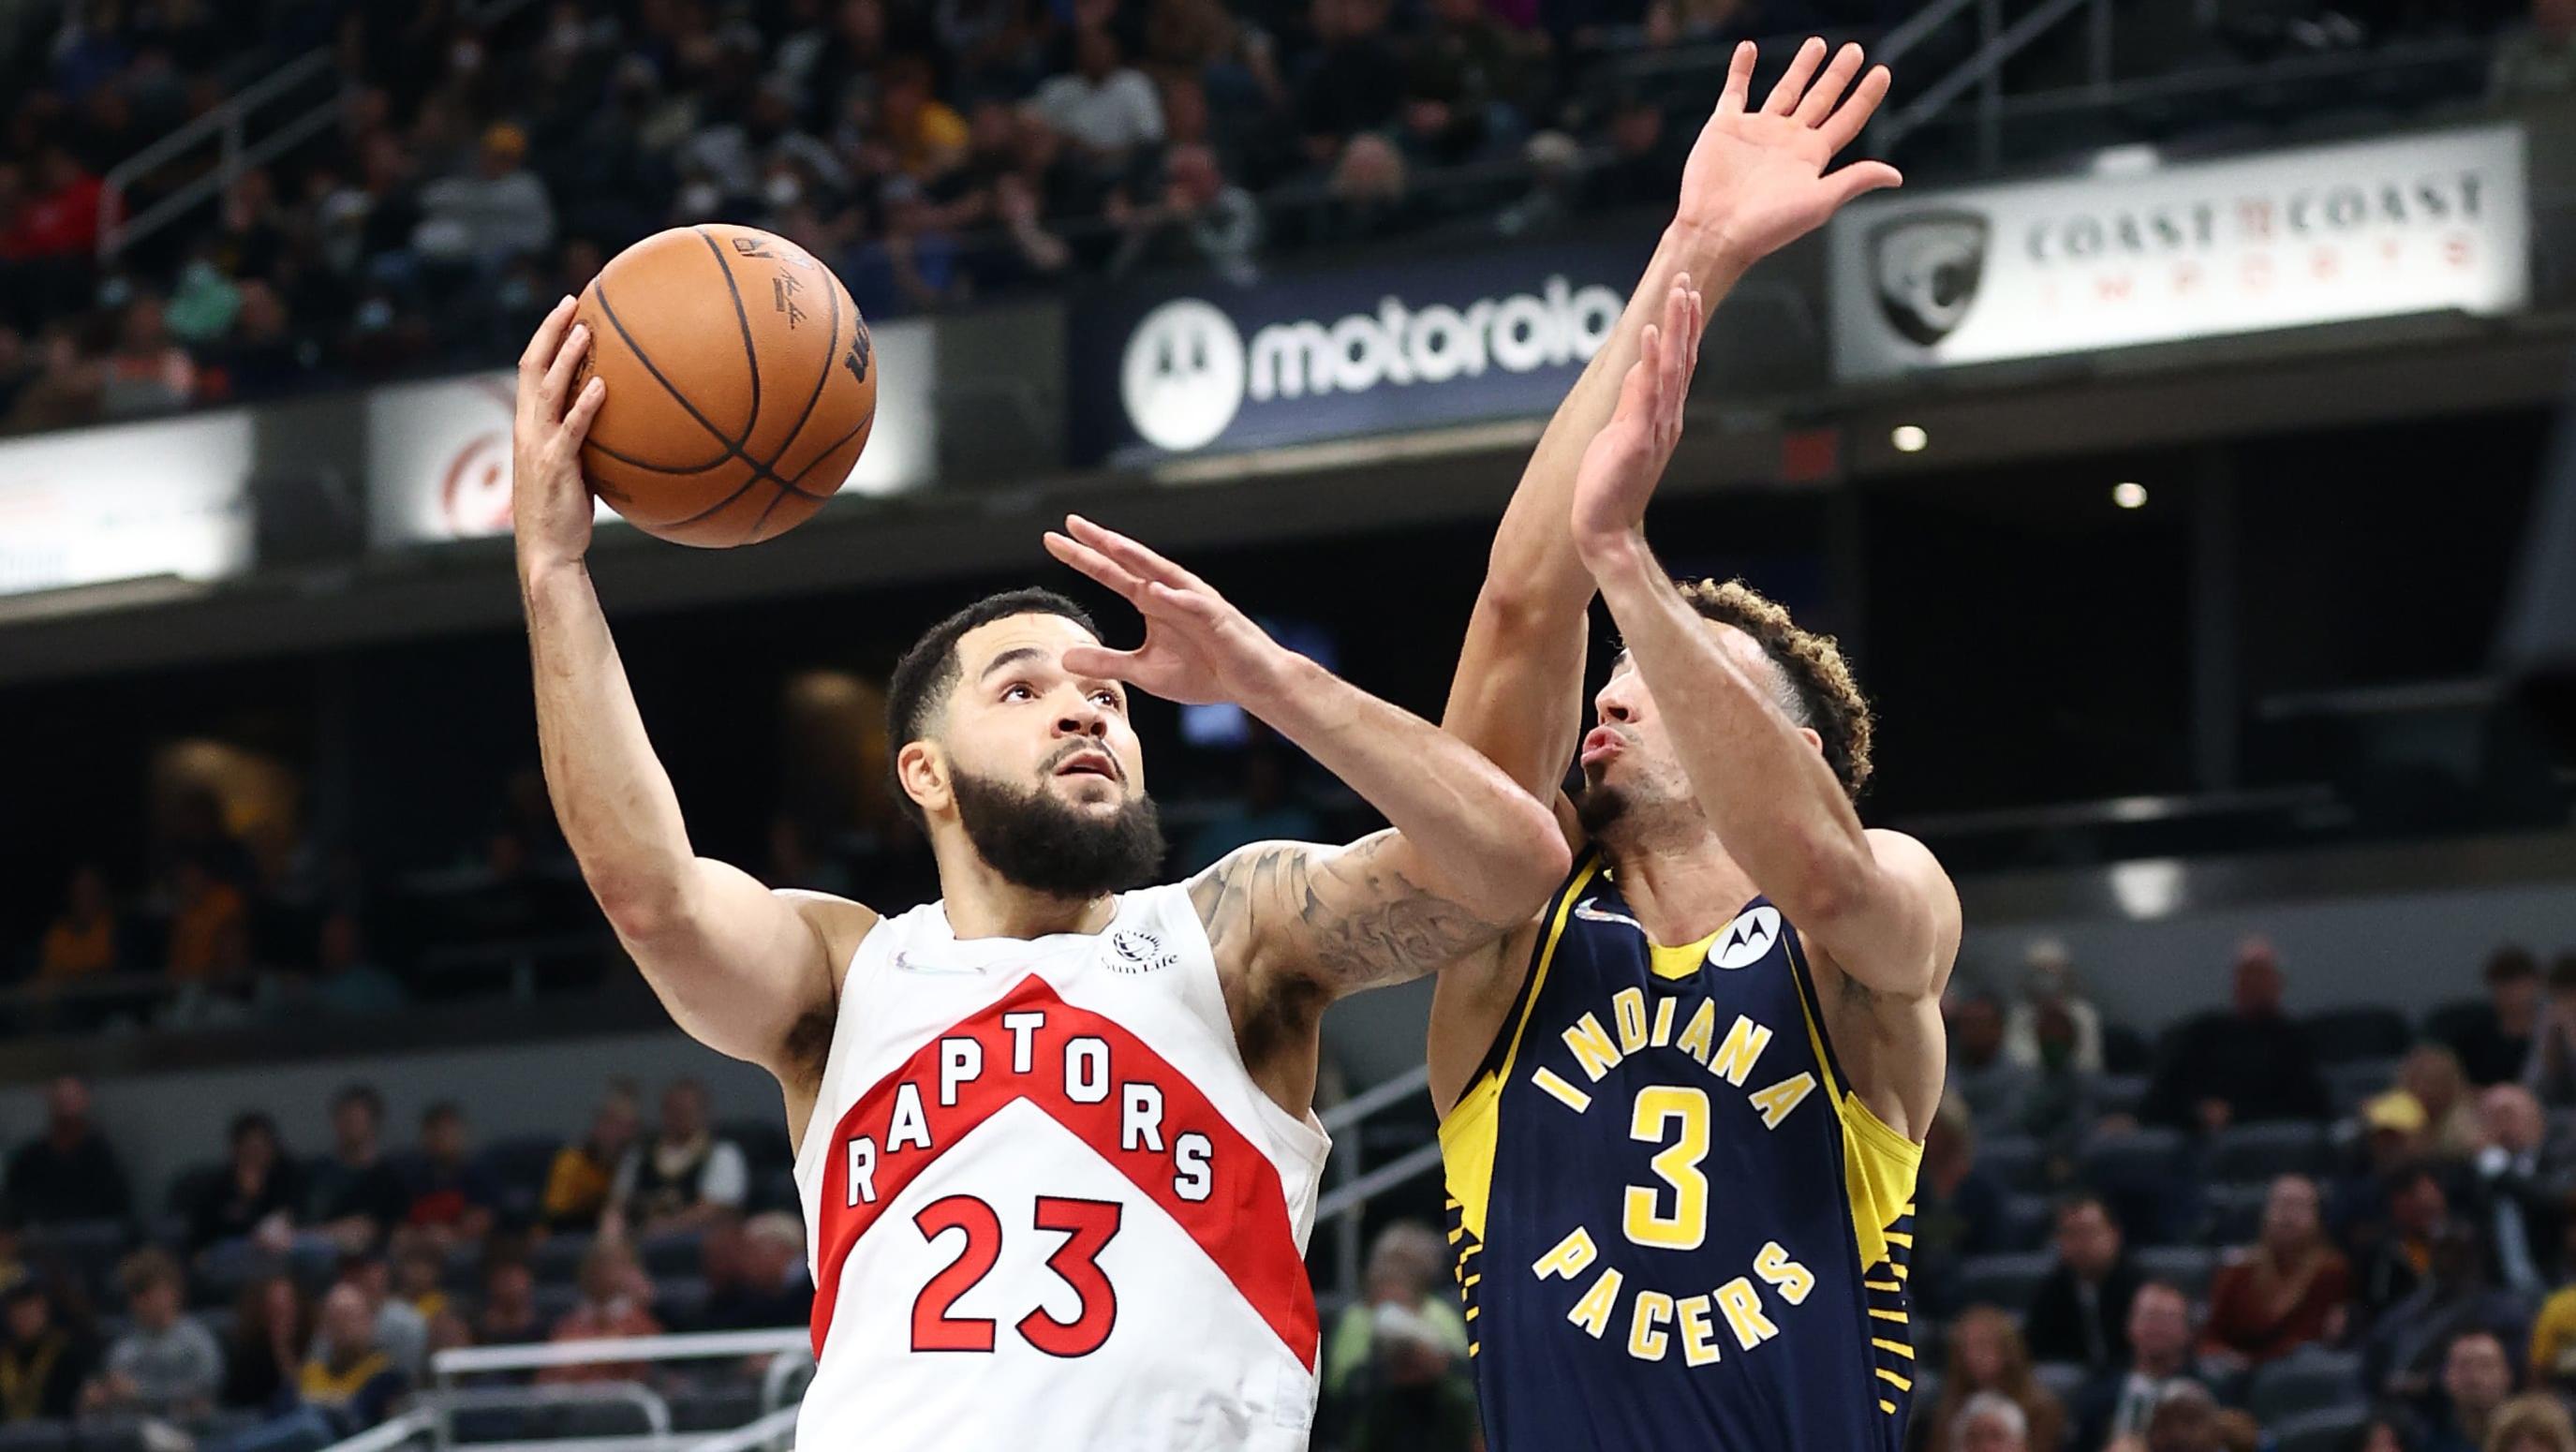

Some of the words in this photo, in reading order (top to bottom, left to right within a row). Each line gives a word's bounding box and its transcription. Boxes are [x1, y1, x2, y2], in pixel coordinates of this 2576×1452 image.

[2024, 201, 2213, 263] COAST
[2287, 172, 2481, 234] COAST
[1101, 956, 1137, 975] Sun
[1143, 953, 1179, 973] Life
[847, 1012, 1213, 1208] RAPTORS
[1532, 986, 1816, 1131] INDIANA
[1623, 1086, 1710, 1251] 3
[910, 1194, 1123, 1358] 23
[1532, 1226, 1815, 1368] PACERS
